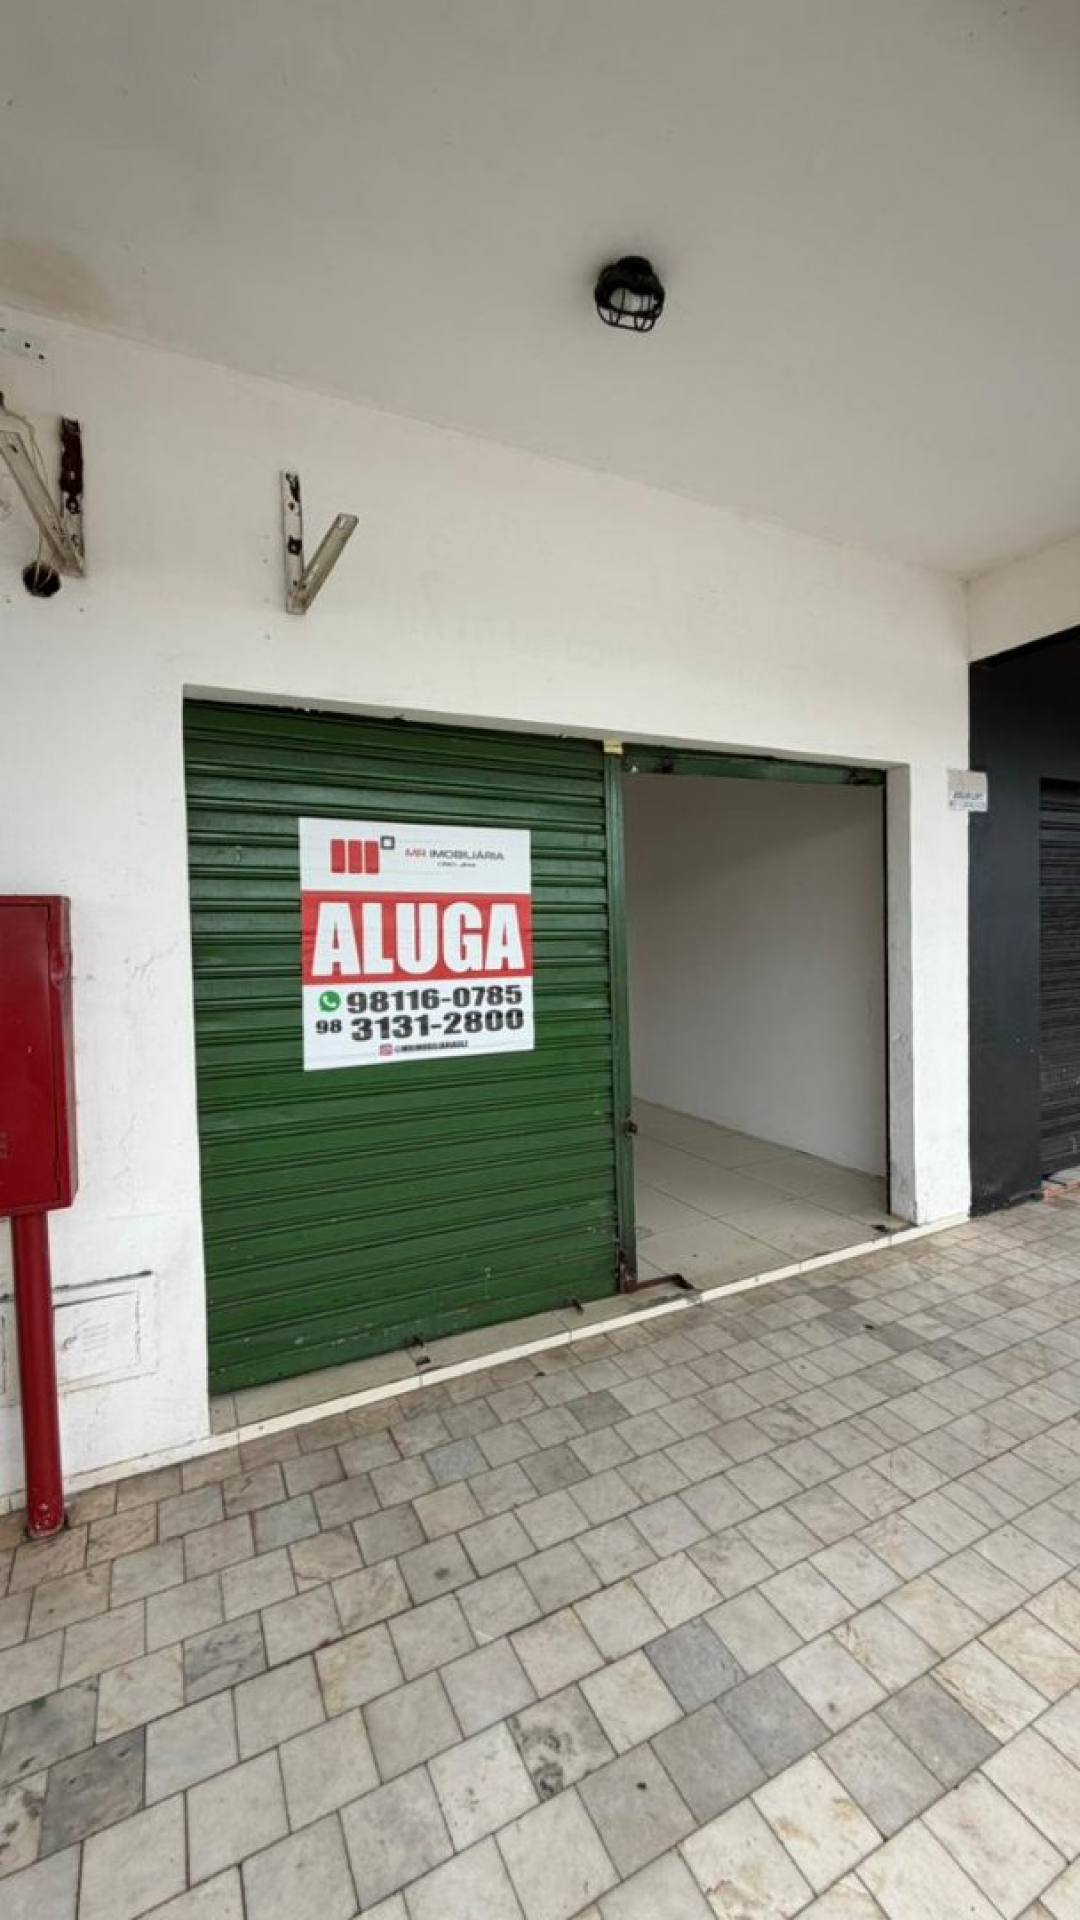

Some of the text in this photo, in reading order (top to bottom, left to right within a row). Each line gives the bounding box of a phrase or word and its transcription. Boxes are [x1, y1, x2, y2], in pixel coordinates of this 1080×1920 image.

[311, 902, 525, 976] ALUGA
[347, 985, 523, 1014] 98116-0785
[315, 1009, 524, 1041] 98 3131-2800
